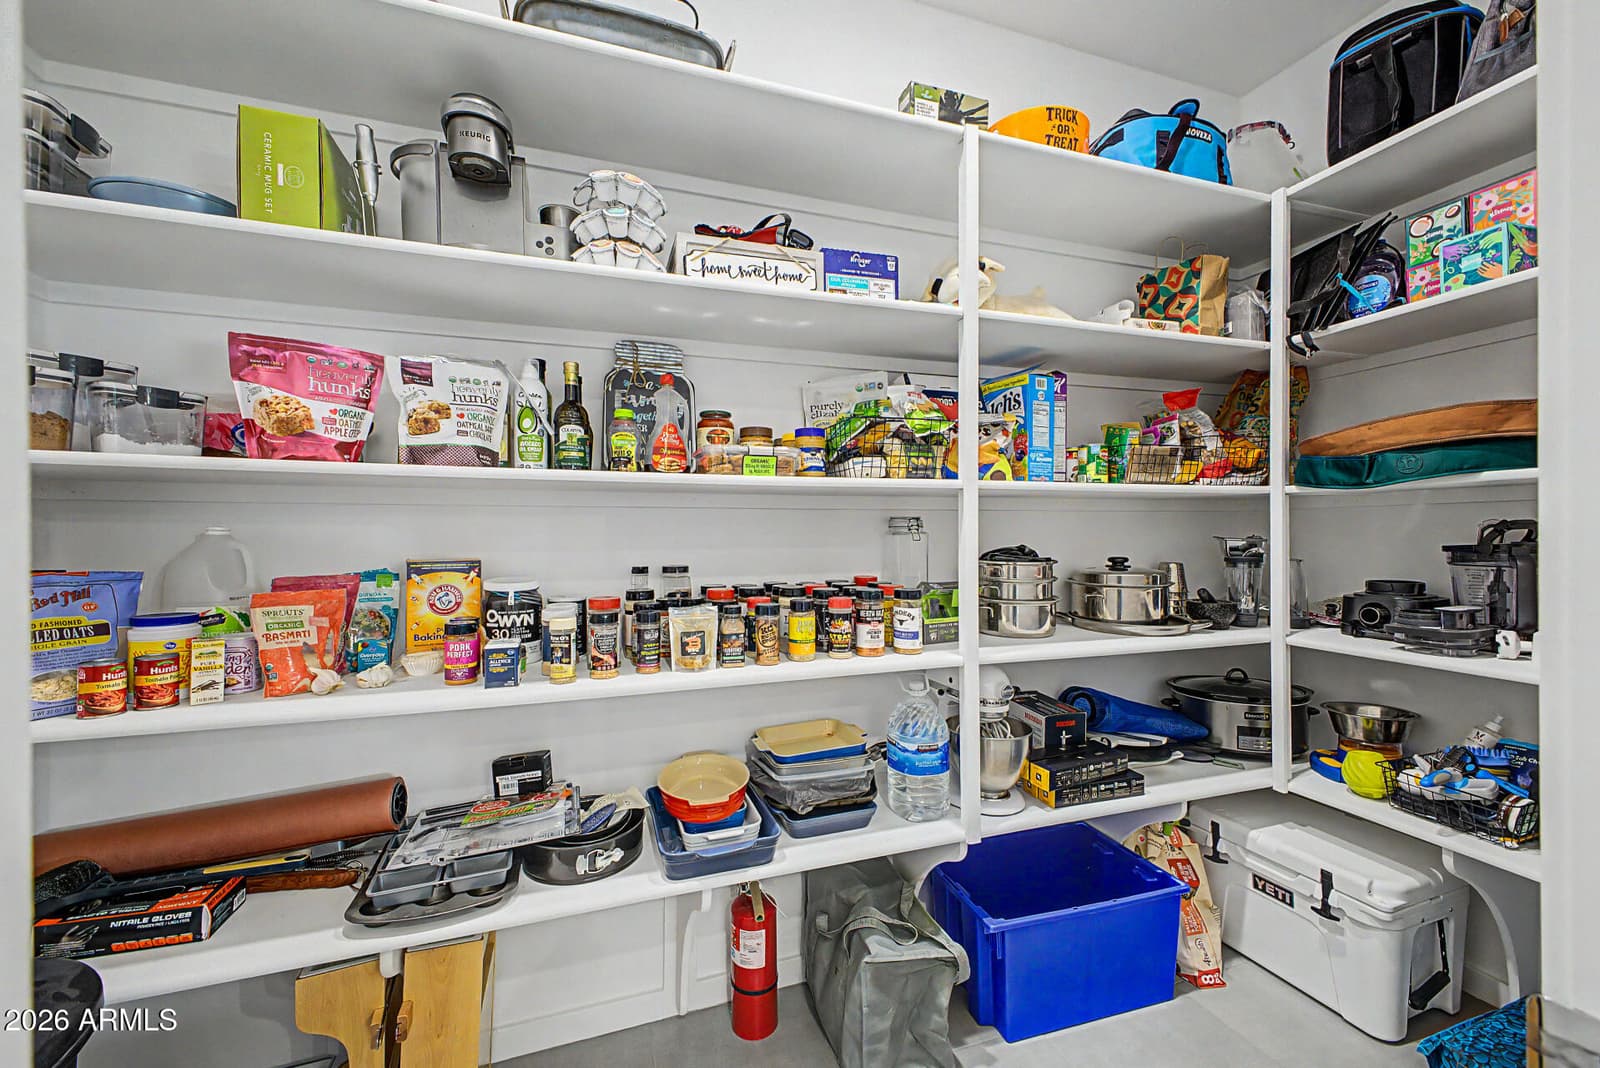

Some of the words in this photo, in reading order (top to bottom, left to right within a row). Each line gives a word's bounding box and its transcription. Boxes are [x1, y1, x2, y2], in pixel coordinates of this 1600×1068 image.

[1045, 107, 1078, 126] TRICK
[458, 130, 492, 143] KEURIG
[1057, 123, 1070, 135] OR
[1045, 134, 1079, 151] TREAT
[264, 132, 273, 171] CERAMIC
[265, 173, 273, 195] MUG
[265, 196, 273, 214] SET
[850, 253, 872, 268] Kroger
[692, 257, 738, 279] home
[738, 261, 772, 281] sweet
[773, 265, 812, 285] home
[307, 376, 371, 400] hunks
[452, 391, 499, 407] hunks
[810, 400, 843, 414] purely
[324, 426, 349, 438] APPLE
[60, 584, 91, 608] Mill
[261, 608, 305, 617] SPROUTS
[486, 609, 535, 628] OWYN
[39, 619, 83, 629] FASHIONED
[62, 625, 96, 639] OATS
[261, 629, 312, 643] BASMATI
[491, 629, 510, 640] 30
[446, 650, 473, 659] PERFECT
[449, 643, 472, 652] PORK
[1254, 876, 1291, 905] YETI
[109, 916, 149, 929] NITRILE
[152, 911, 193, 924] GLOVES
